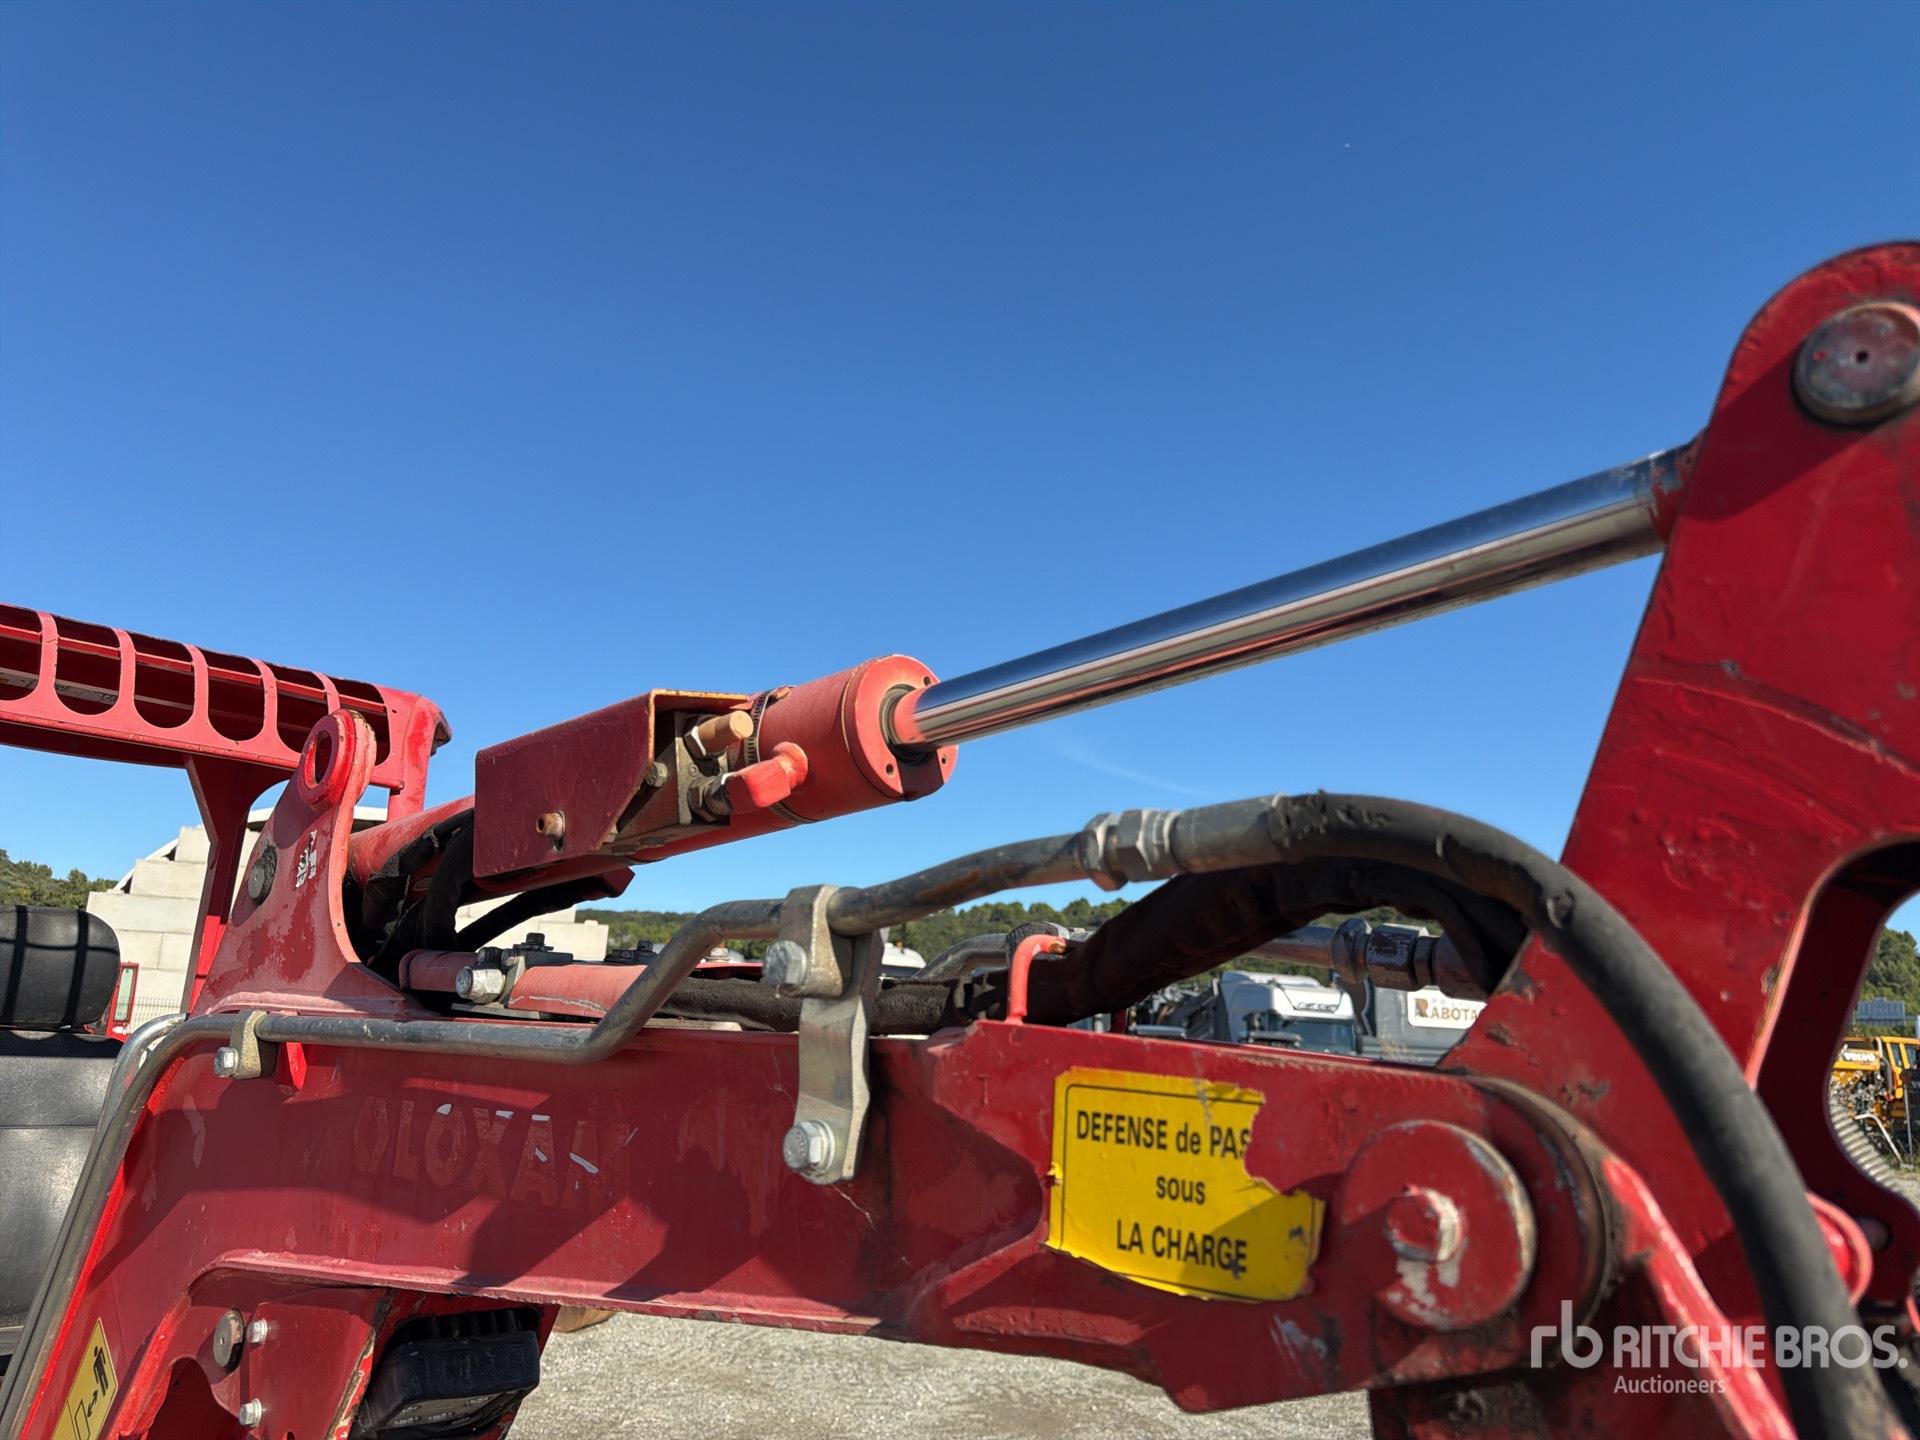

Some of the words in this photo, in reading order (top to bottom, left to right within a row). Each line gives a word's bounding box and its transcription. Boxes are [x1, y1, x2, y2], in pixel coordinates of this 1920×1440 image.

[1415, 998, 1483, 1020] RABOTA
[1076, 1110, 1168, 1150] DEFENSE
[1175, 1122, 1201, 1155] de
[1156, 1175, 1206, 1205] sous
[1116, 1219, 1144, 1255] LA
[1151, 1225, 1247, 1273] CHARGE
